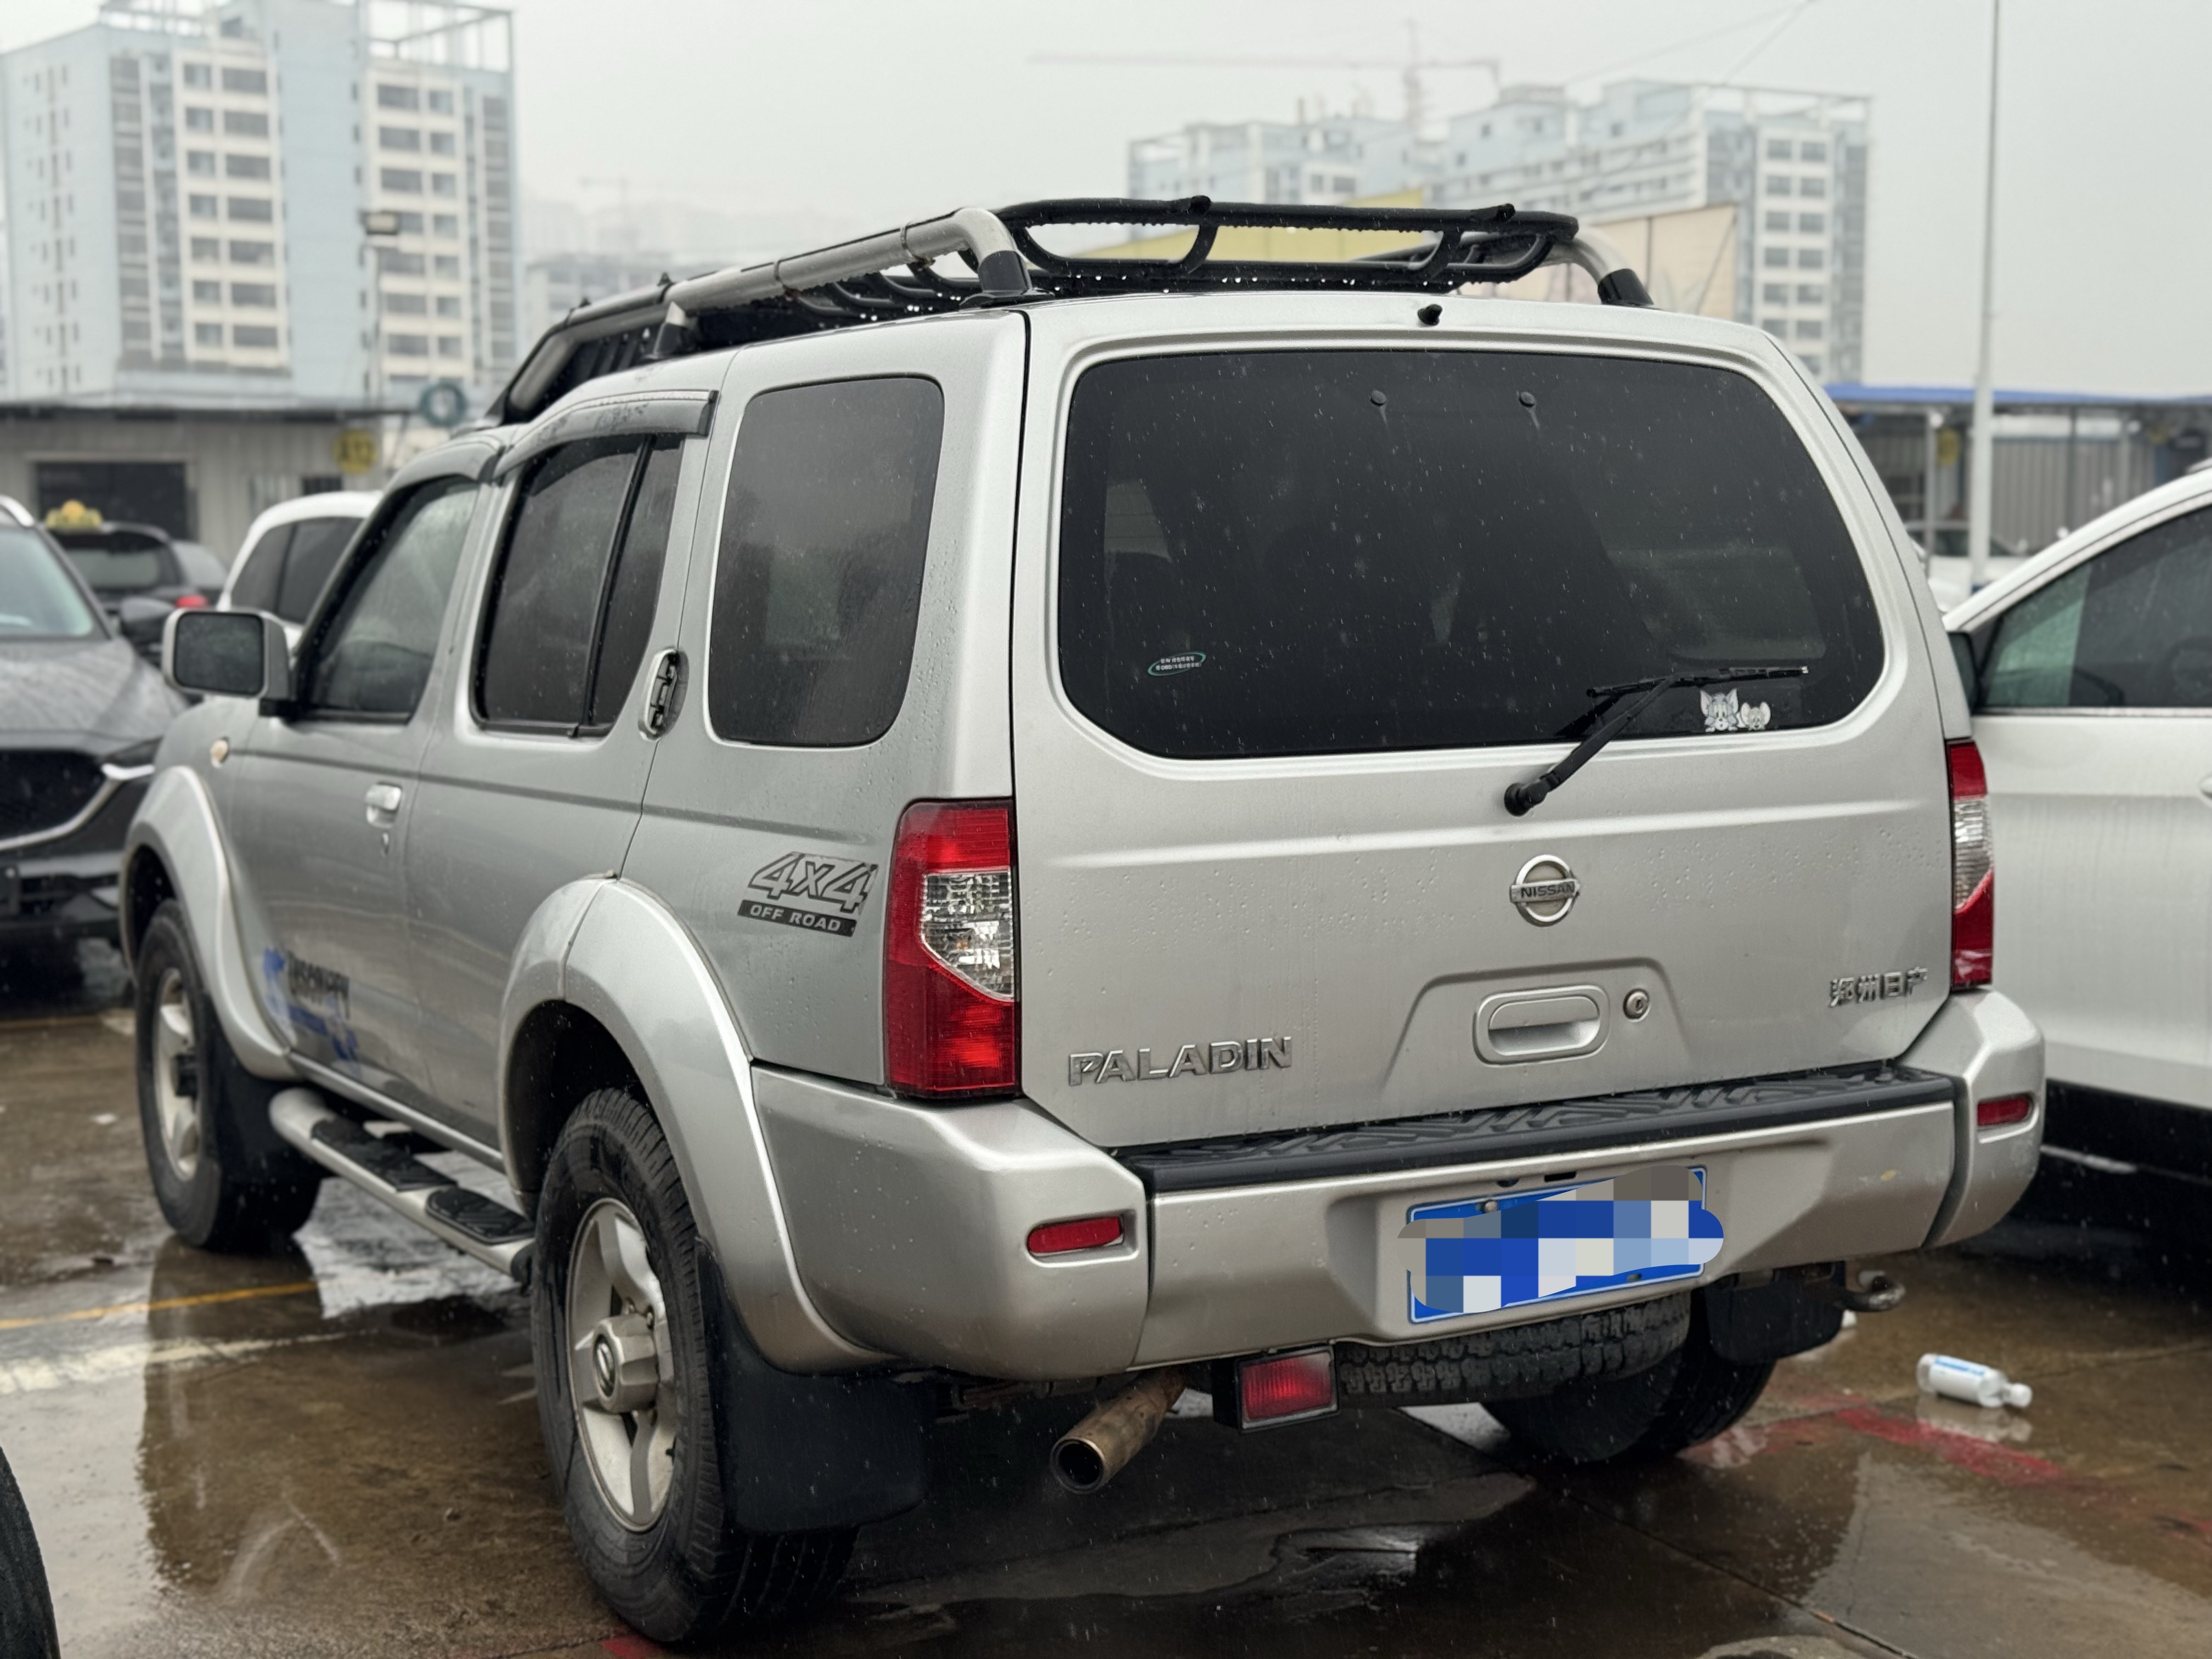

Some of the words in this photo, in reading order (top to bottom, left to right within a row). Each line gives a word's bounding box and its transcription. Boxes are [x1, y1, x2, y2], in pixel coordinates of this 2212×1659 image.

[1520, 882, 1575, 898] NISSAN
[750, 905, 785, 920] OFF
[789, 912, 841, 932] ROAD
[1829, 967, 1928, 1007] 郑州日产
[1068, 1036, 1292, 1087] PALADIN
